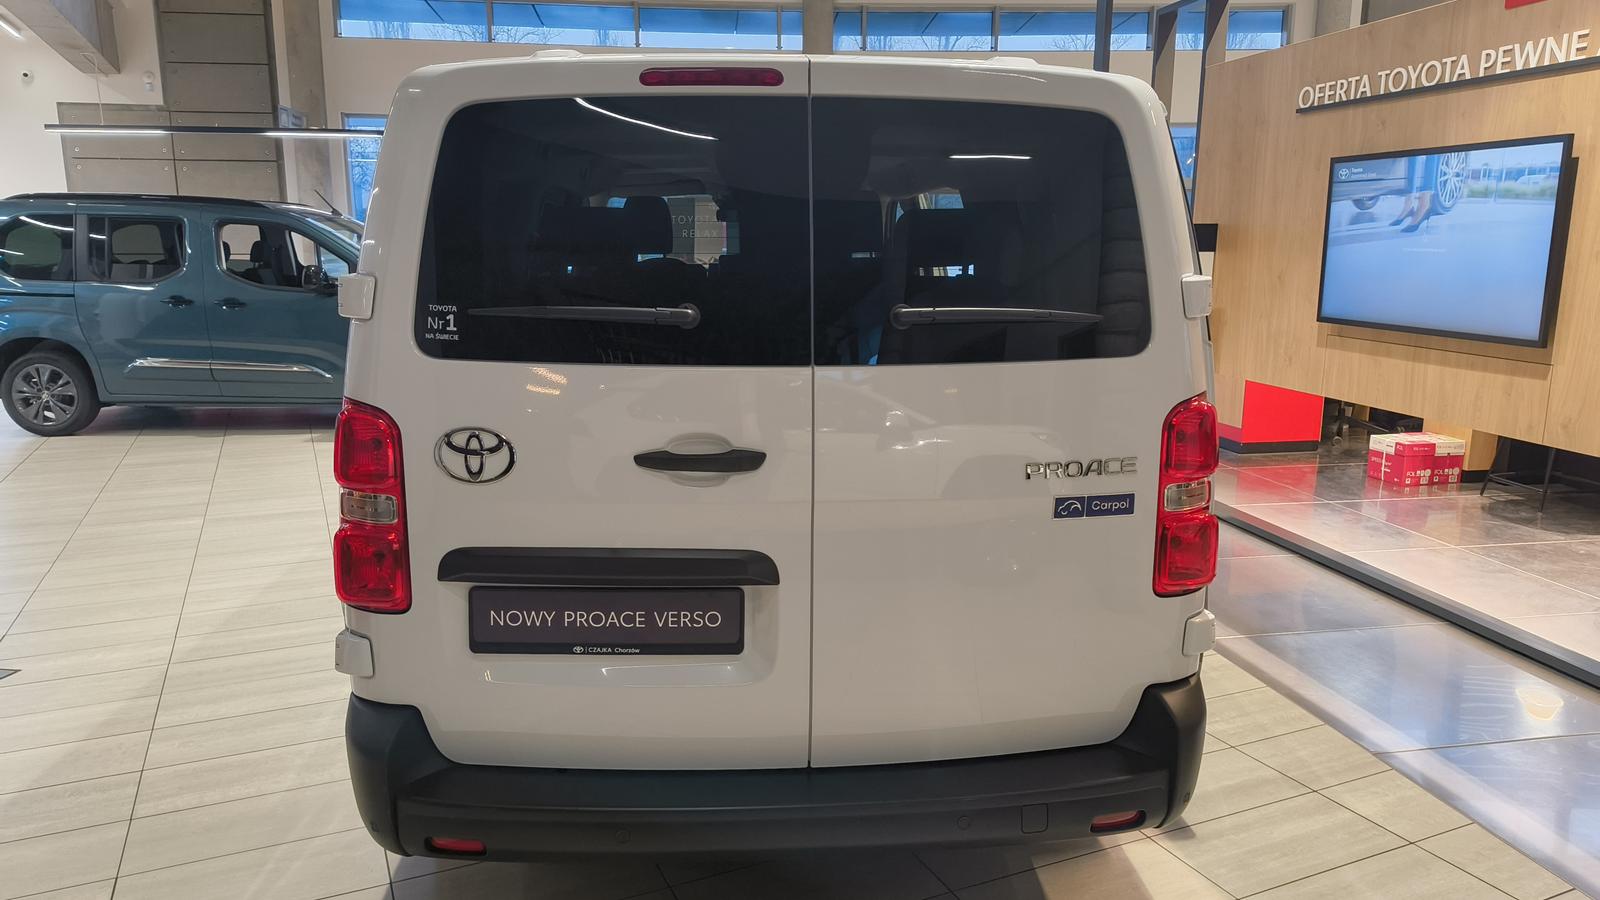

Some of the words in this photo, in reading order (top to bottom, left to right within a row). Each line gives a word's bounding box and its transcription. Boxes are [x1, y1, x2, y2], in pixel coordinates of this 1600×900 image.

[1298, 76, 1371, 109] OFERTA
[1377, 54, 1472, 93] TOYOTA
[1479, 28, 1591, 78] PEWNE
[682, 229, 717, 238] RELAX
[428, 304, 458, 312] TOYOTA
[1025, 456, 1138, 480] PROACE
[1091, 498, 1130, 512] Carpol
[489, 610, 556, 628] NOWY
[564, 611, 646, 628] PROACE
[654, 611, 722, 628] VERSO
